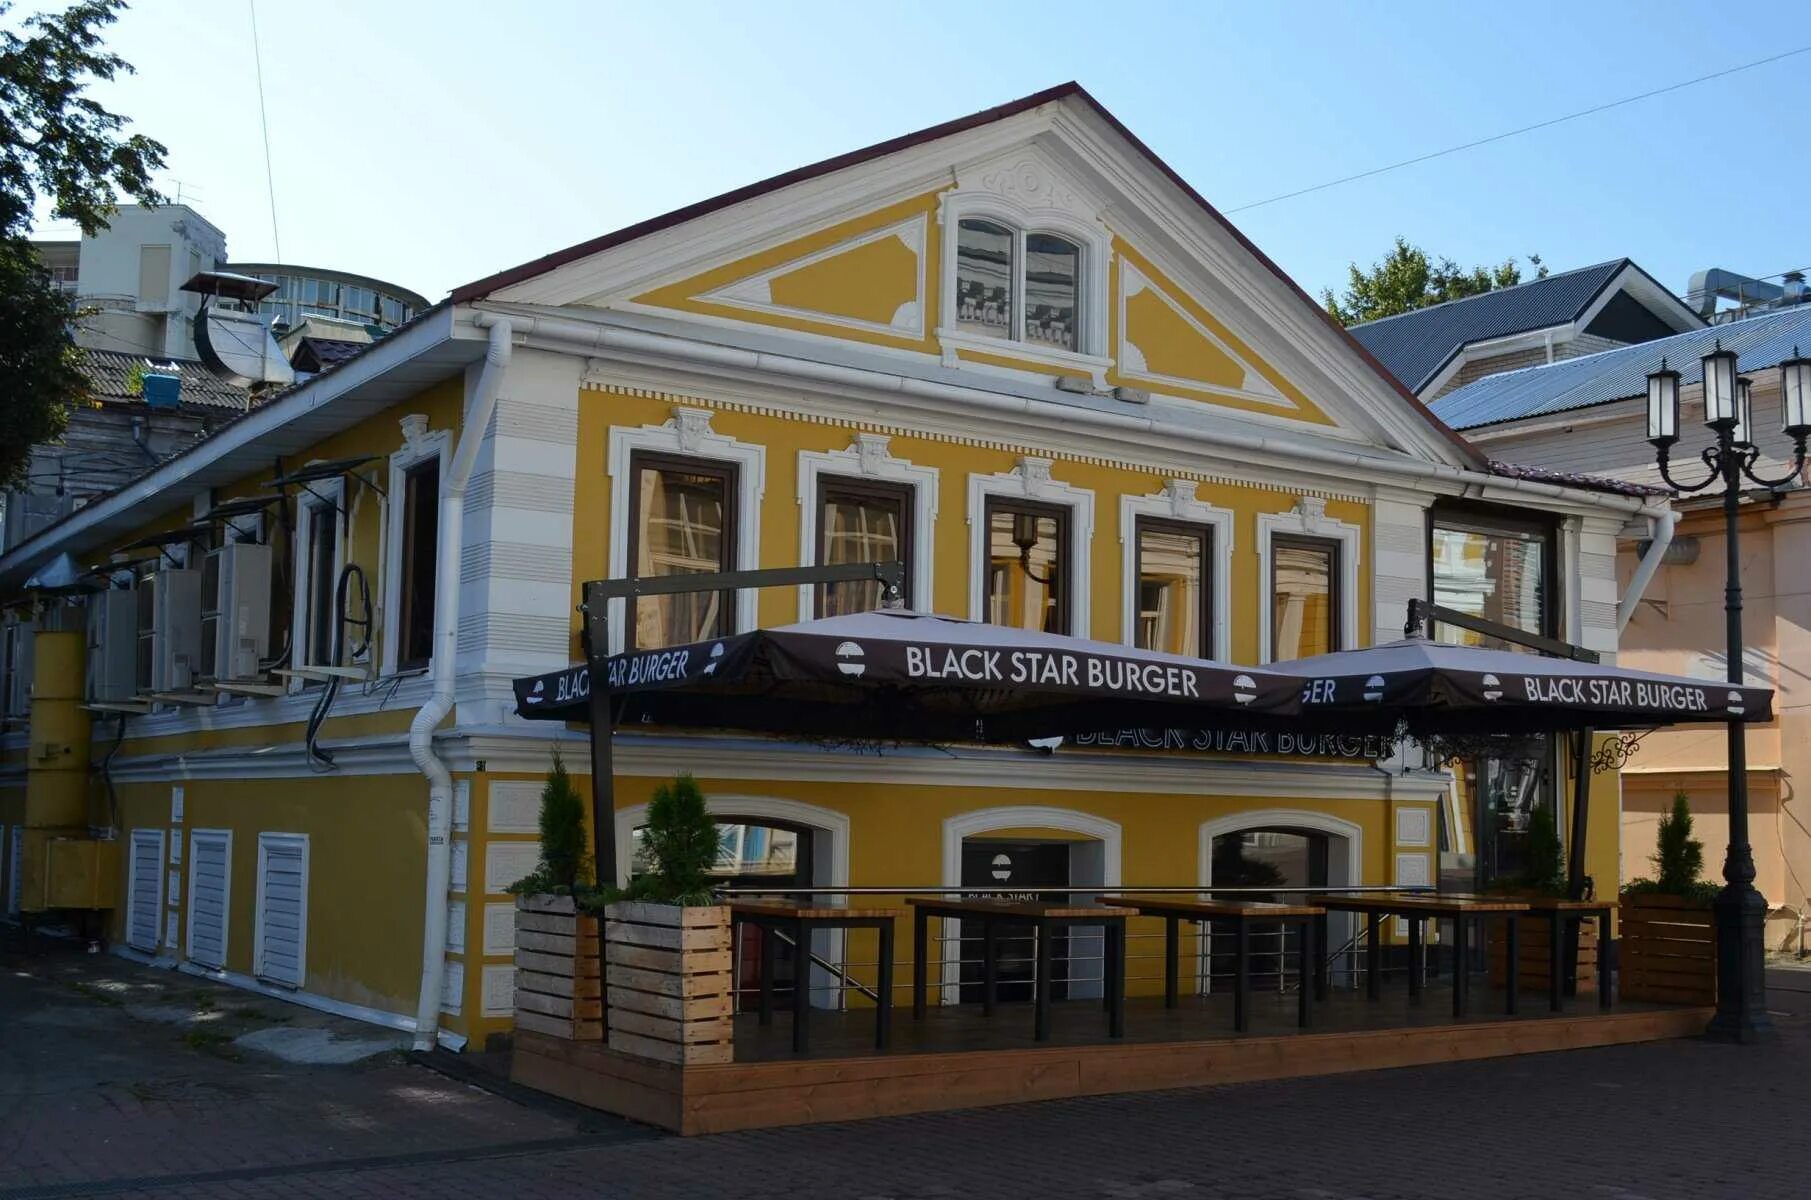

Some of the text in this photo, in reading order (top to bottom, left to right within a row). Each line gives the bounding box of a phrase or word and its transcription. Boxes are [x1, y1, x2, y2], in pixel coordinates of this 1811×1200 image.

[557, 669, 589, 701] BLAC
[629, 650, 689, 682] BURGER
[906, 647, 1199, 698] BLACK STAR BURGER
[1524, 677, 1707, 711] BLACK STAR BURGER
